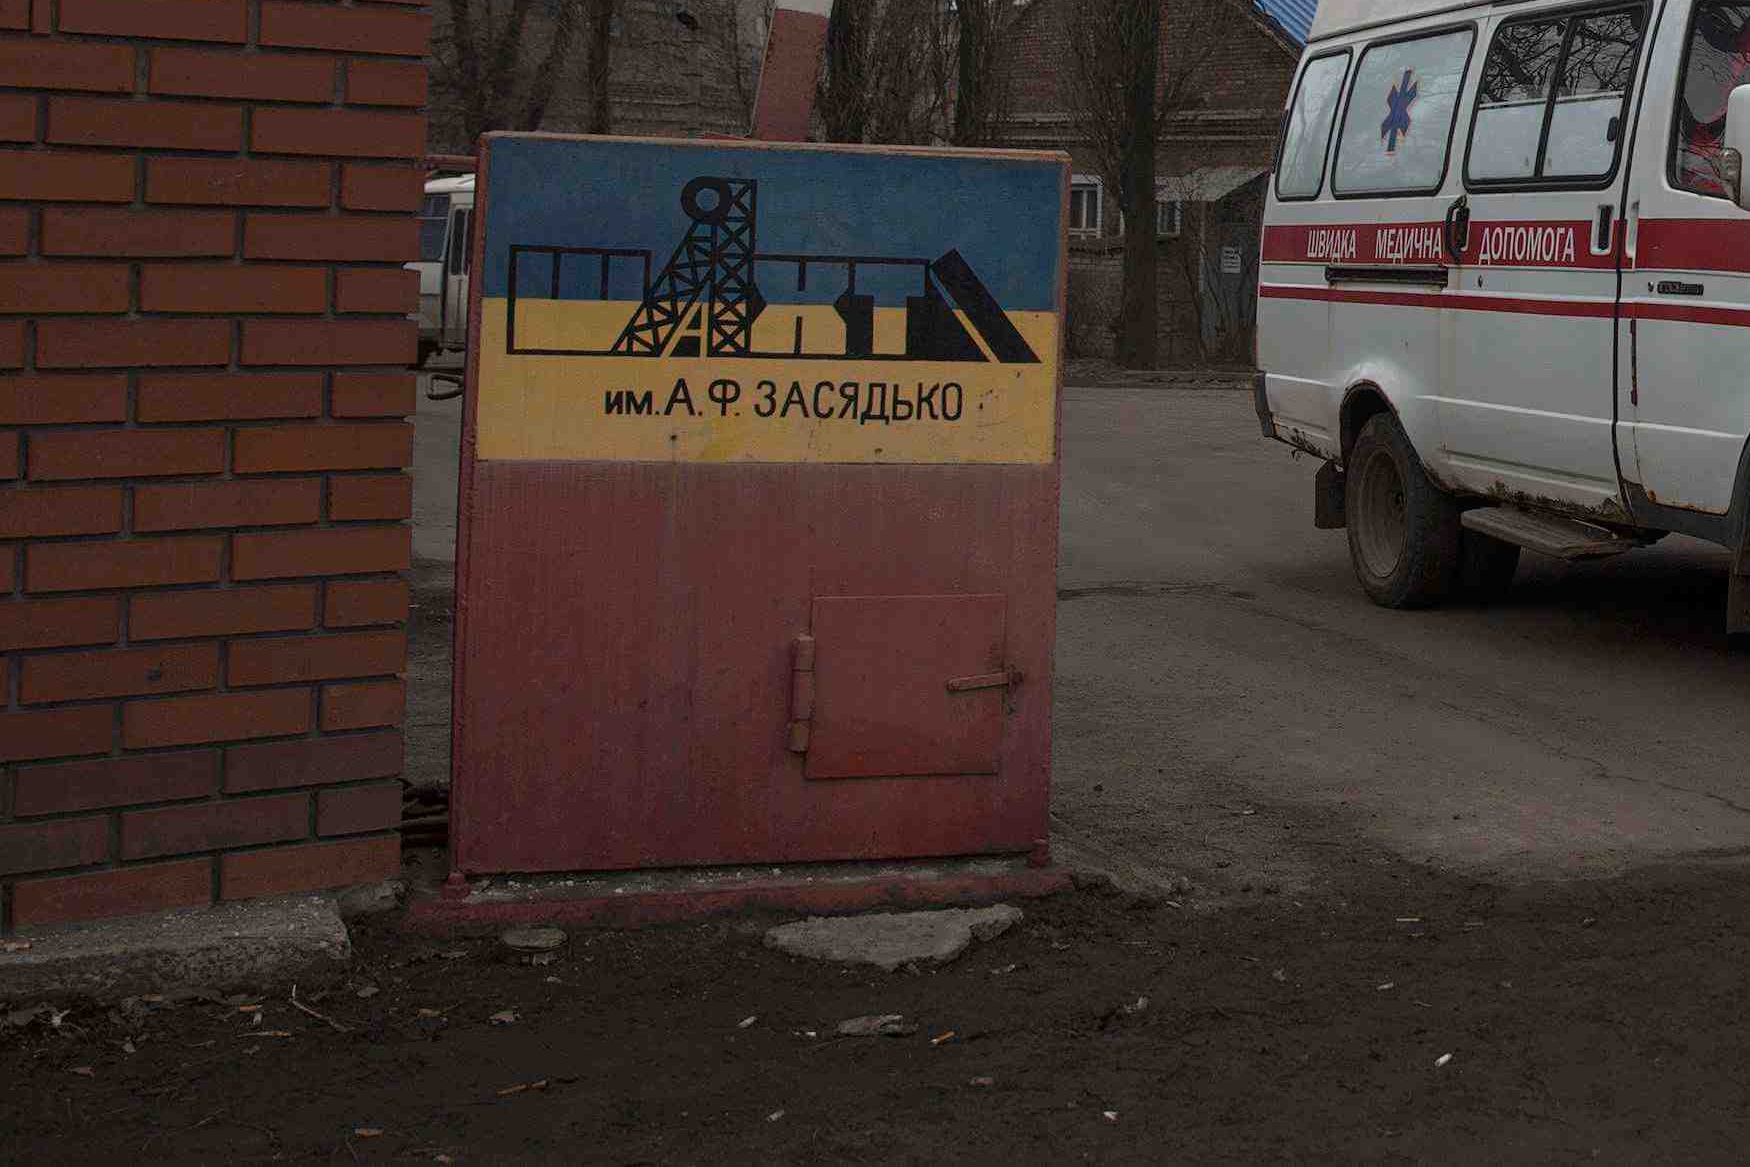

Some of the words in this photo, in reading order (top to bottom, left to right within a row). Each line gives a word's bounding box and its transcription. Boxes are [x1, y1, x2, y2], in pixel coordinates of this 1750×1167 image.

[1307, 229, 1356, 265] ШВИДКА
[1375, 227, 1443, 265] МЕДИЧНА
[1479, 225, 1575, 266] ДОПОМОГА
[753, 379, 963, 423] ЗАСЯДЬКО
